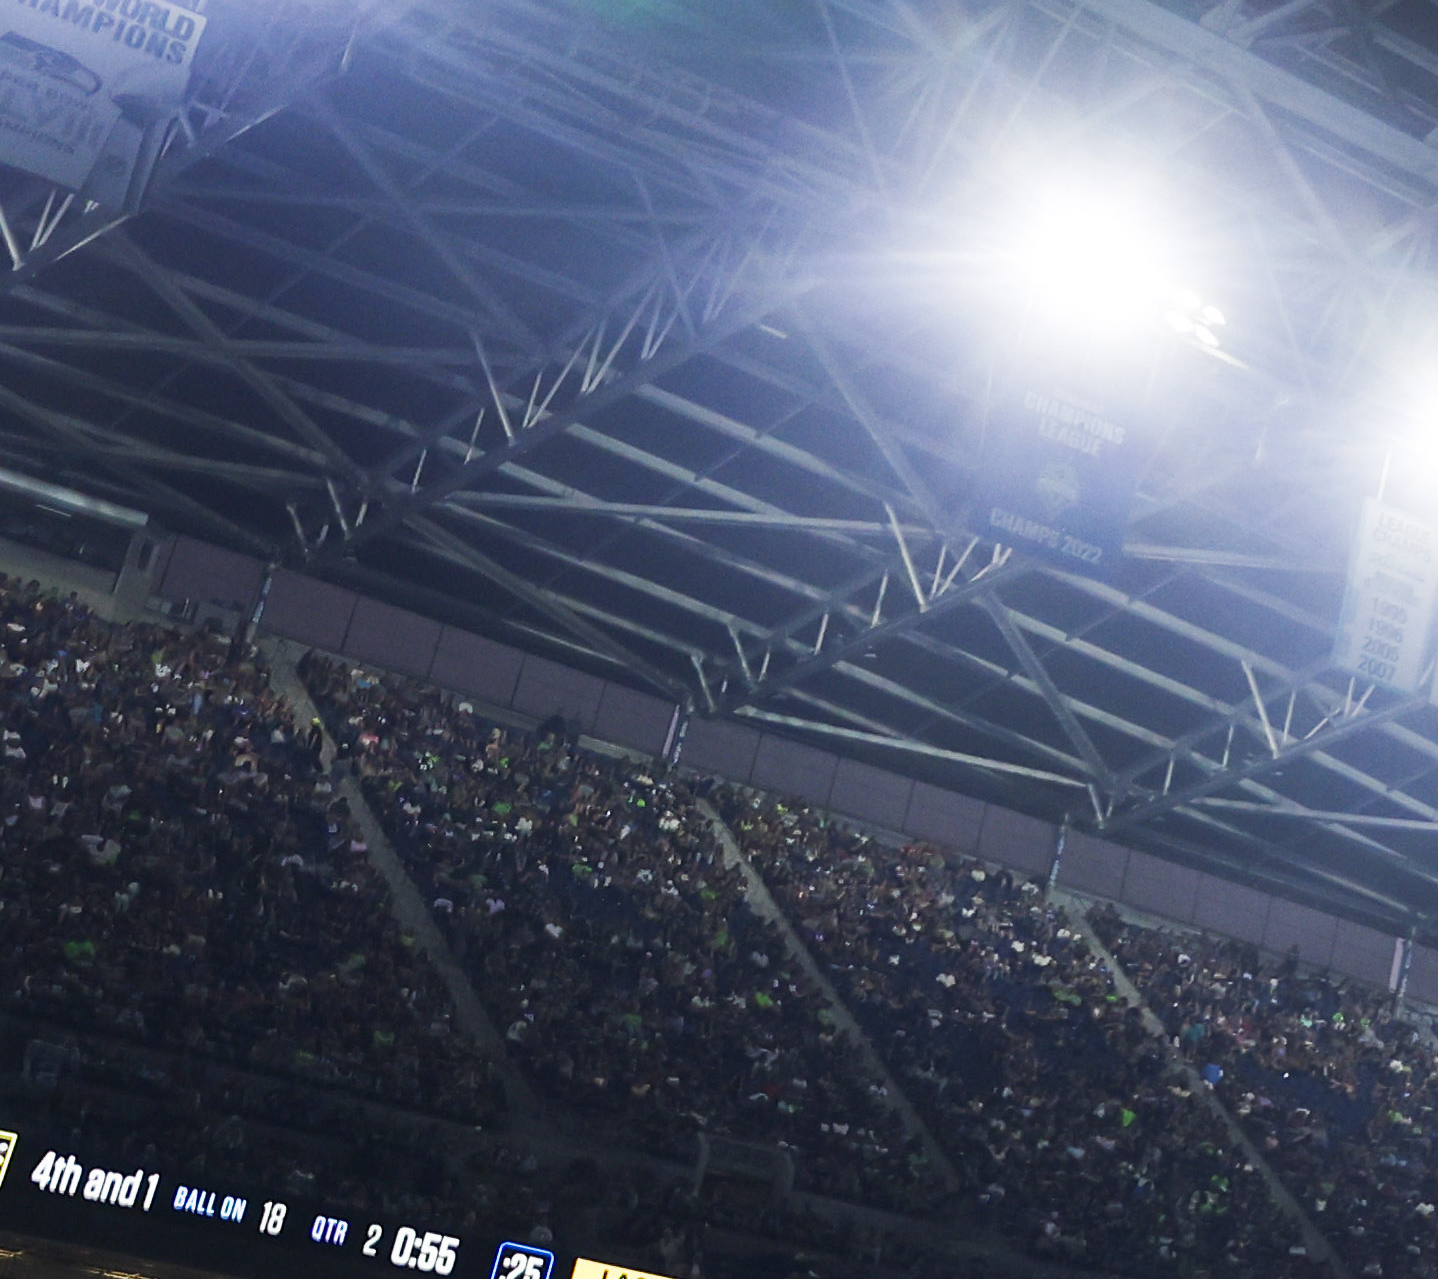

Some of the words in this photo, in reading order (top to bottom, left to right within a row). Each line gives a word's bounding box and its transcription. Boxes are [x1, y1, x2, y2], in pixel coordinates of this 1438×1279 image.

[31, 1151, 82, 1197] 4th
[83, 1165, 144, 1208] and
[143, 1173, 160, 1211] 1
[172, 1185, 216, 1217] BALL
[220, 1195, 247, 1223] ON
[259, 1201, 287, 1236] 18
[311, 1215, 350, 1246] QTR
[362, 1224, 382, 1257] 2
[390, 1227, 460, 1276] 0:55
